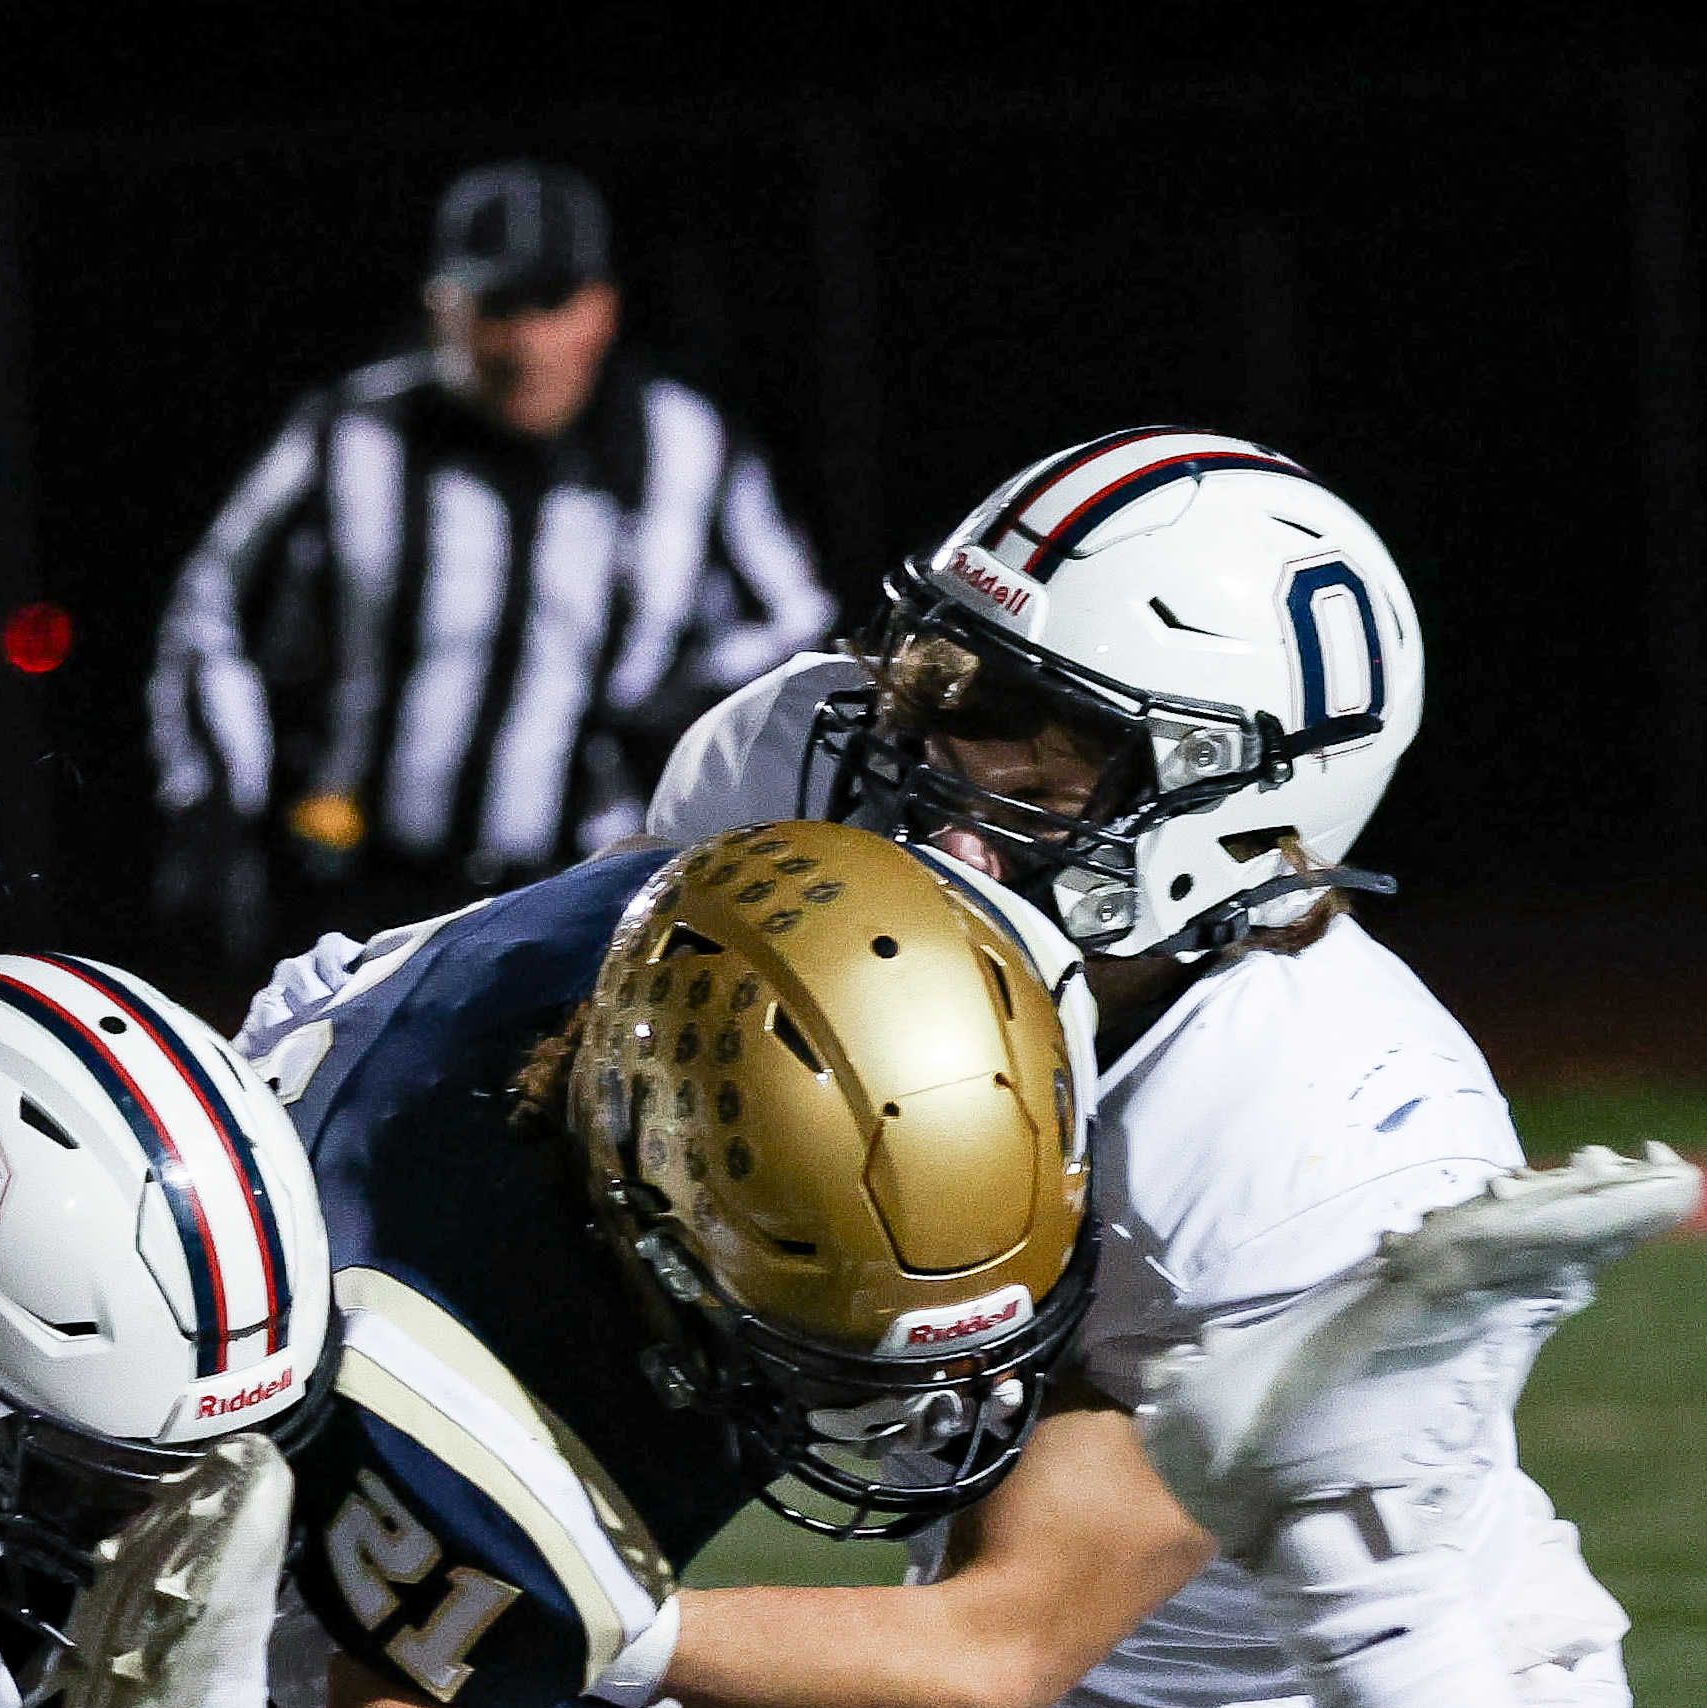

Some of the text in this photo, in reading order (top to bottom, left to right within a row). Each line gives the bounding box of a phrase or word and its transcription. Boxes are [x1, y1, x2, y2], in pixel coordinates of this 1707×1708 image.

[908, 1299, 1022, 1343] Riddell
[196, 1366, 292, 1420] Riddell
[325, 1467, 525, 1703] 21
